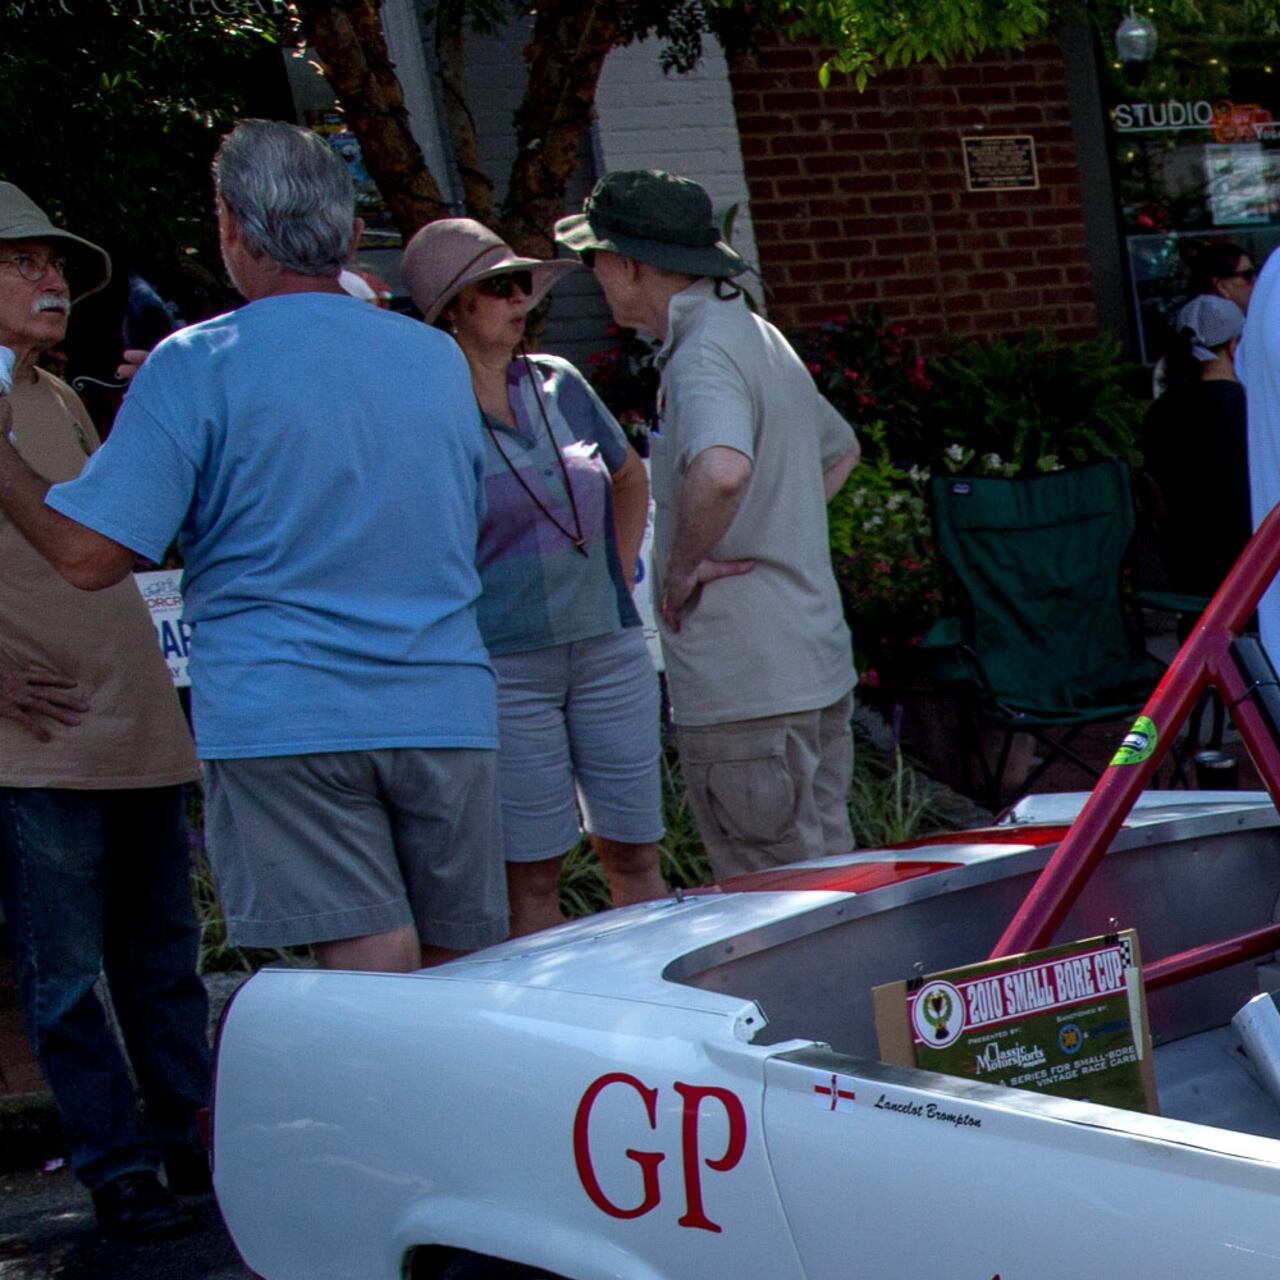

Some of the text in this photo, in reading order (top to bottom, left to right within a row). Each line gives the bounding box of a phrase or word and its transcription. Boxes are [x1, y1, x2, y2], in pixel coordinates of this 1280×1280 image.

[1115, 101, 1213, 128] STUDIO
[966, 950, 1122, 1025] 2010 SMALL BORE CUP
[976, 1044, 1045, 1075] Motorsports
[985, 1041, 1027, 1064] Classic
[1009, 1069, 1048, 1087] SERIES
[1050, 1062, 1071, 1075] FOR
[1073, 1045, 1135, 1069] SMALL-BORE
[1036, 1054, 1137, 1088] VINTAGE RACE CARS
[874, 1094, 982, 1128] Lancelot Brompton
[573, 1071, 748, 1233] GP
